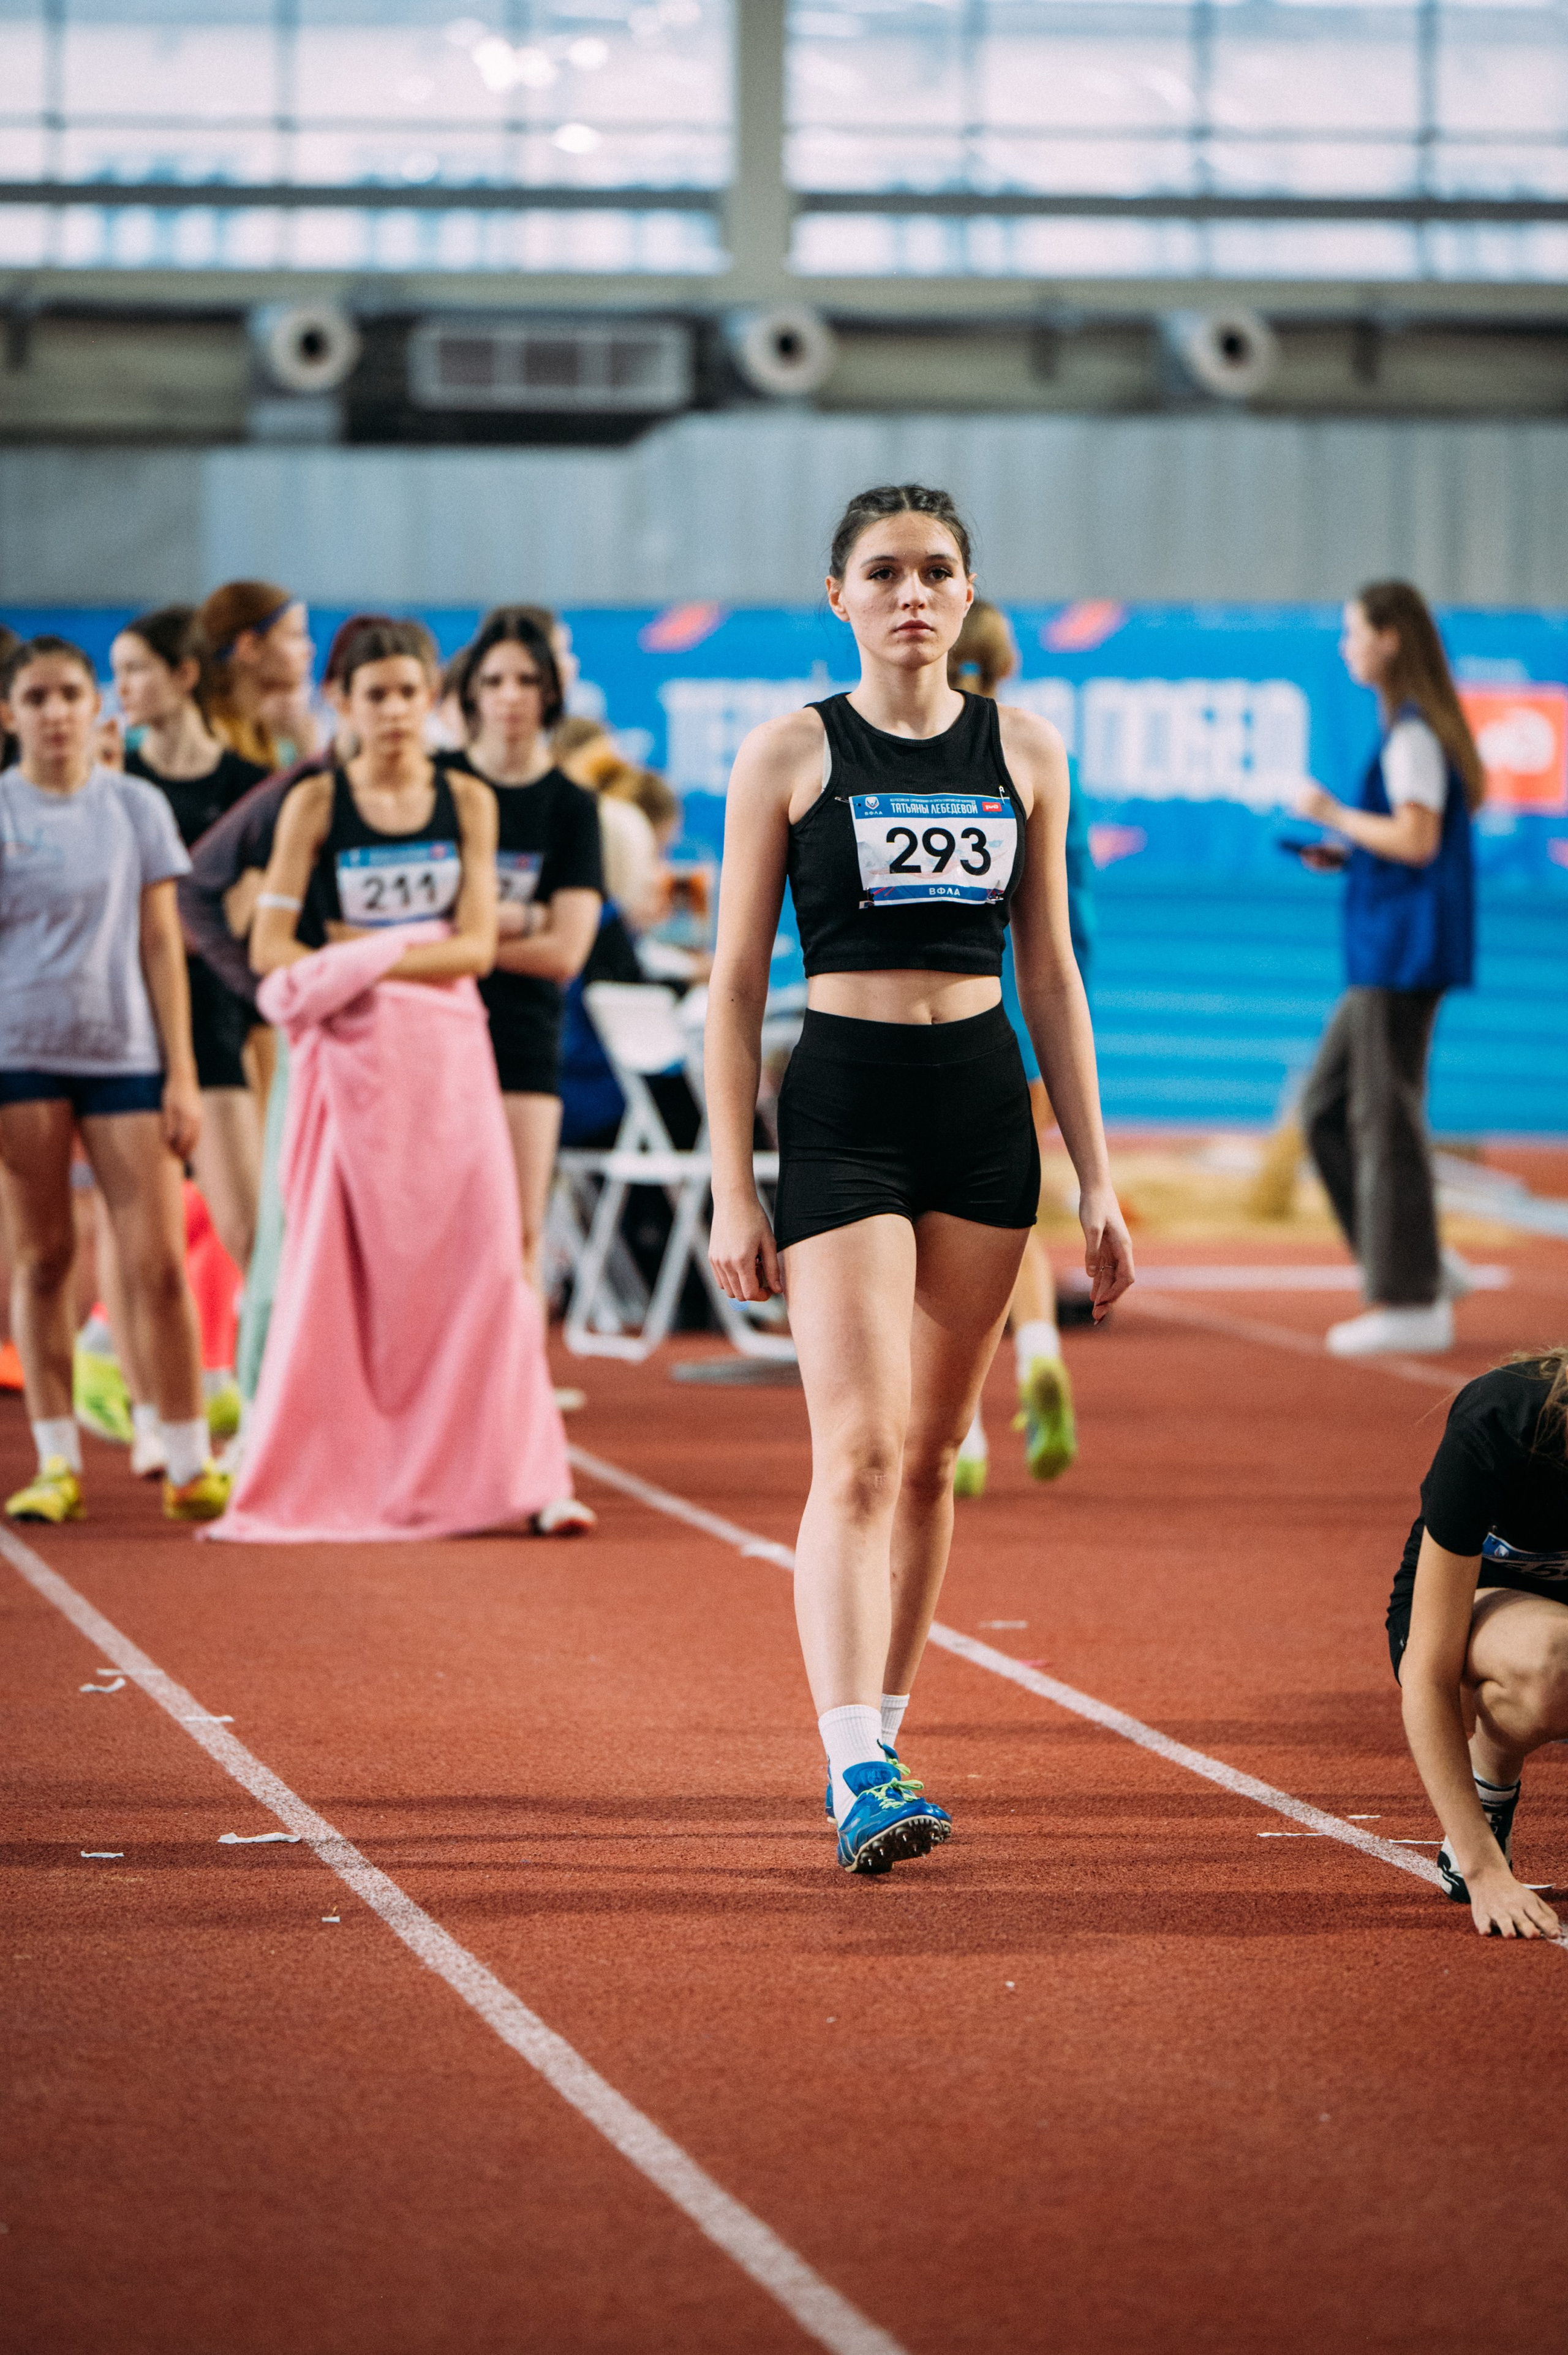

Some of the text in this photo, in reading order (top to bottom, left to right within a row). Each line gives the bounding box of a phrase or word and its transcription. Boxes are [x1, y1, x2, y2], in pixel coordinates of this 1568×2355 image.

[891, 801, 978, 815] ТАТЬЯНЫ ЛЕБЕДЕВОЙ
[886, 827, 991, 876] 293
[364, 874, 436, 910] 211
[929, 887, 960, 896] ВФЛА
